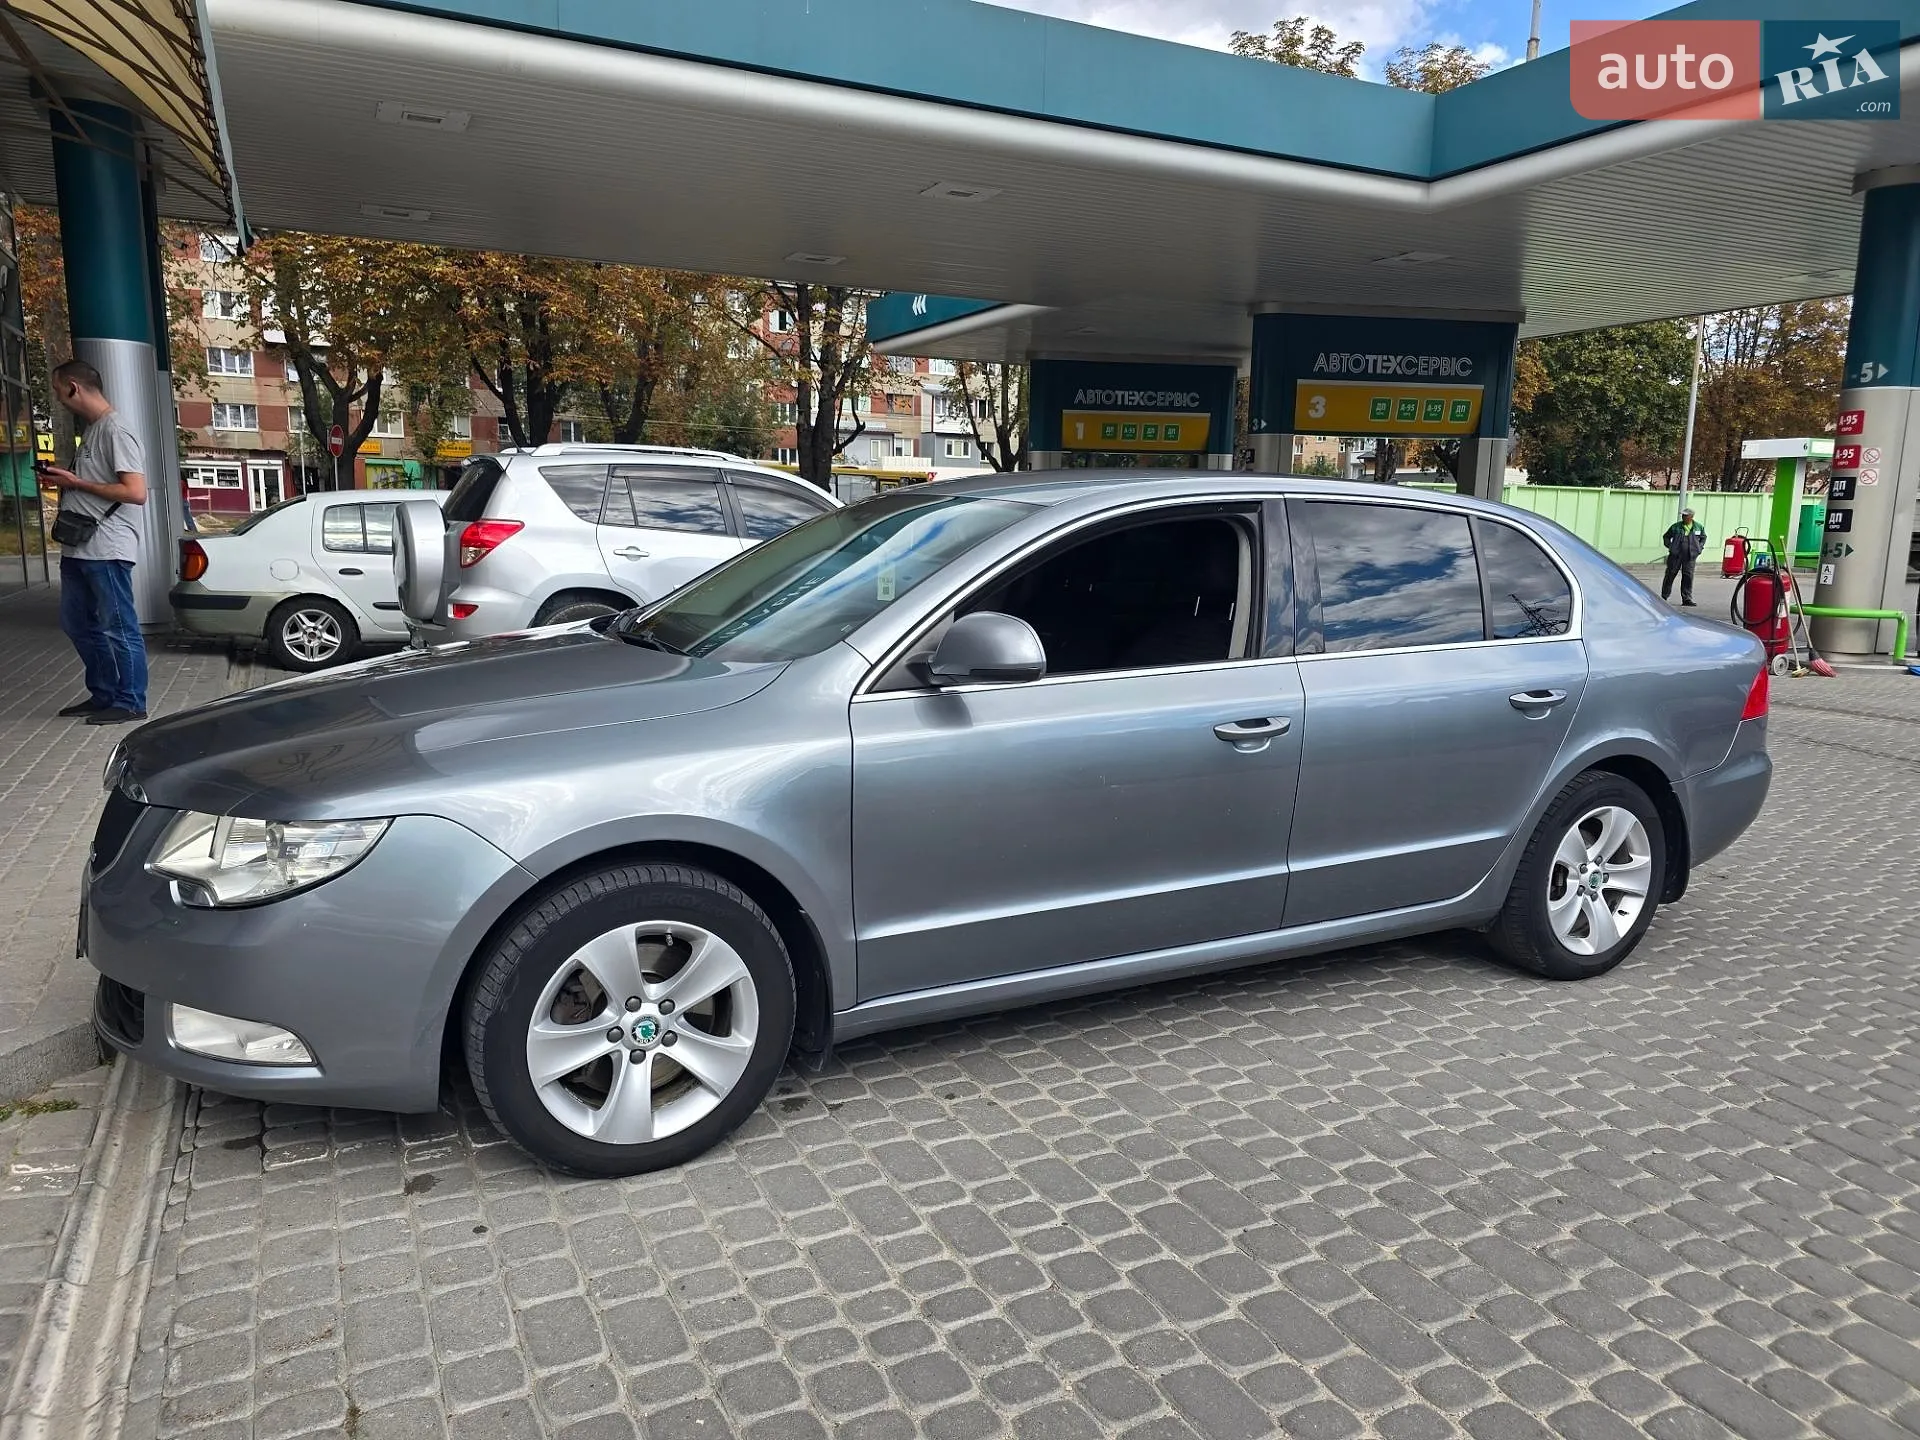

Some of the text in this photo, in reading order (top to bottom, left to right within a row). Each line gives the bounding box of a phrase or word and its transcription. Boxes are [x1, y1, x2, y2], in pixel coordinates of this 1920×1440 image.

[1312, 352, 1473, 378] АВТОТЕХСЕРВІС
[1073, 388, 1200, 409] АВТОТЕХСЕРВІС
[1307, 395, 1328, 419] 3
[1838, 414, 1859, 426] А-95
[1075, 422, 1085, 440] 1
[1802, 442, 1808, 451] 6
[1835, 448, 1855, 459] А-95
[1832, 480, 1846, 492] ДП
[1828, 512, 1843, 524] ДП
